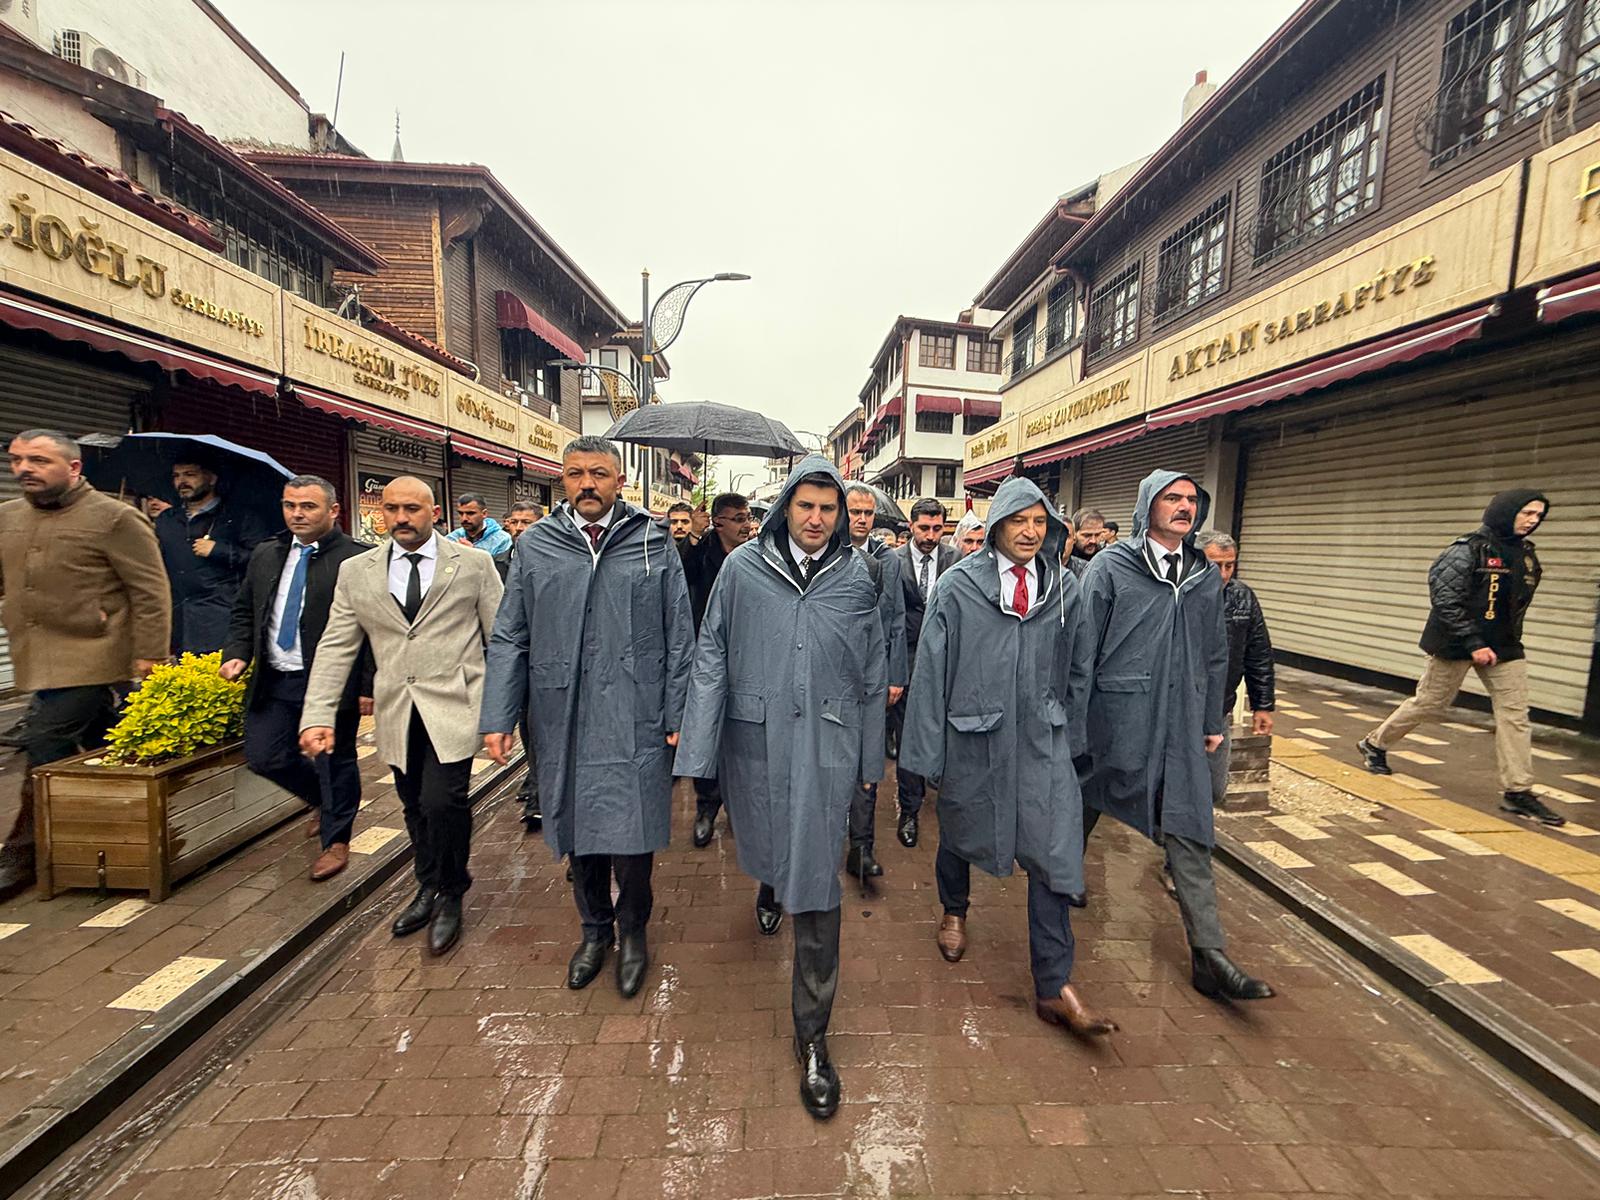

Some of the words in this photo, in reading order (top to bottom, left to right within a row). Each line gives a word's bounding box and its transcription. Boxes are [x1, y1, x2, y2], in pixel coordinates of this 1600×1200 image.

[0, 193, 169, 299] İOĞLU
[170, 288, 264, 338] SARRAFİYE
[303, 317, 396, 380] İBRAHİM
[1167, 319, 1260, 382] AKTAN
[1263, 254, 1437, 344] SARRAFİYE
[515, 480, 541, 498] SENA
